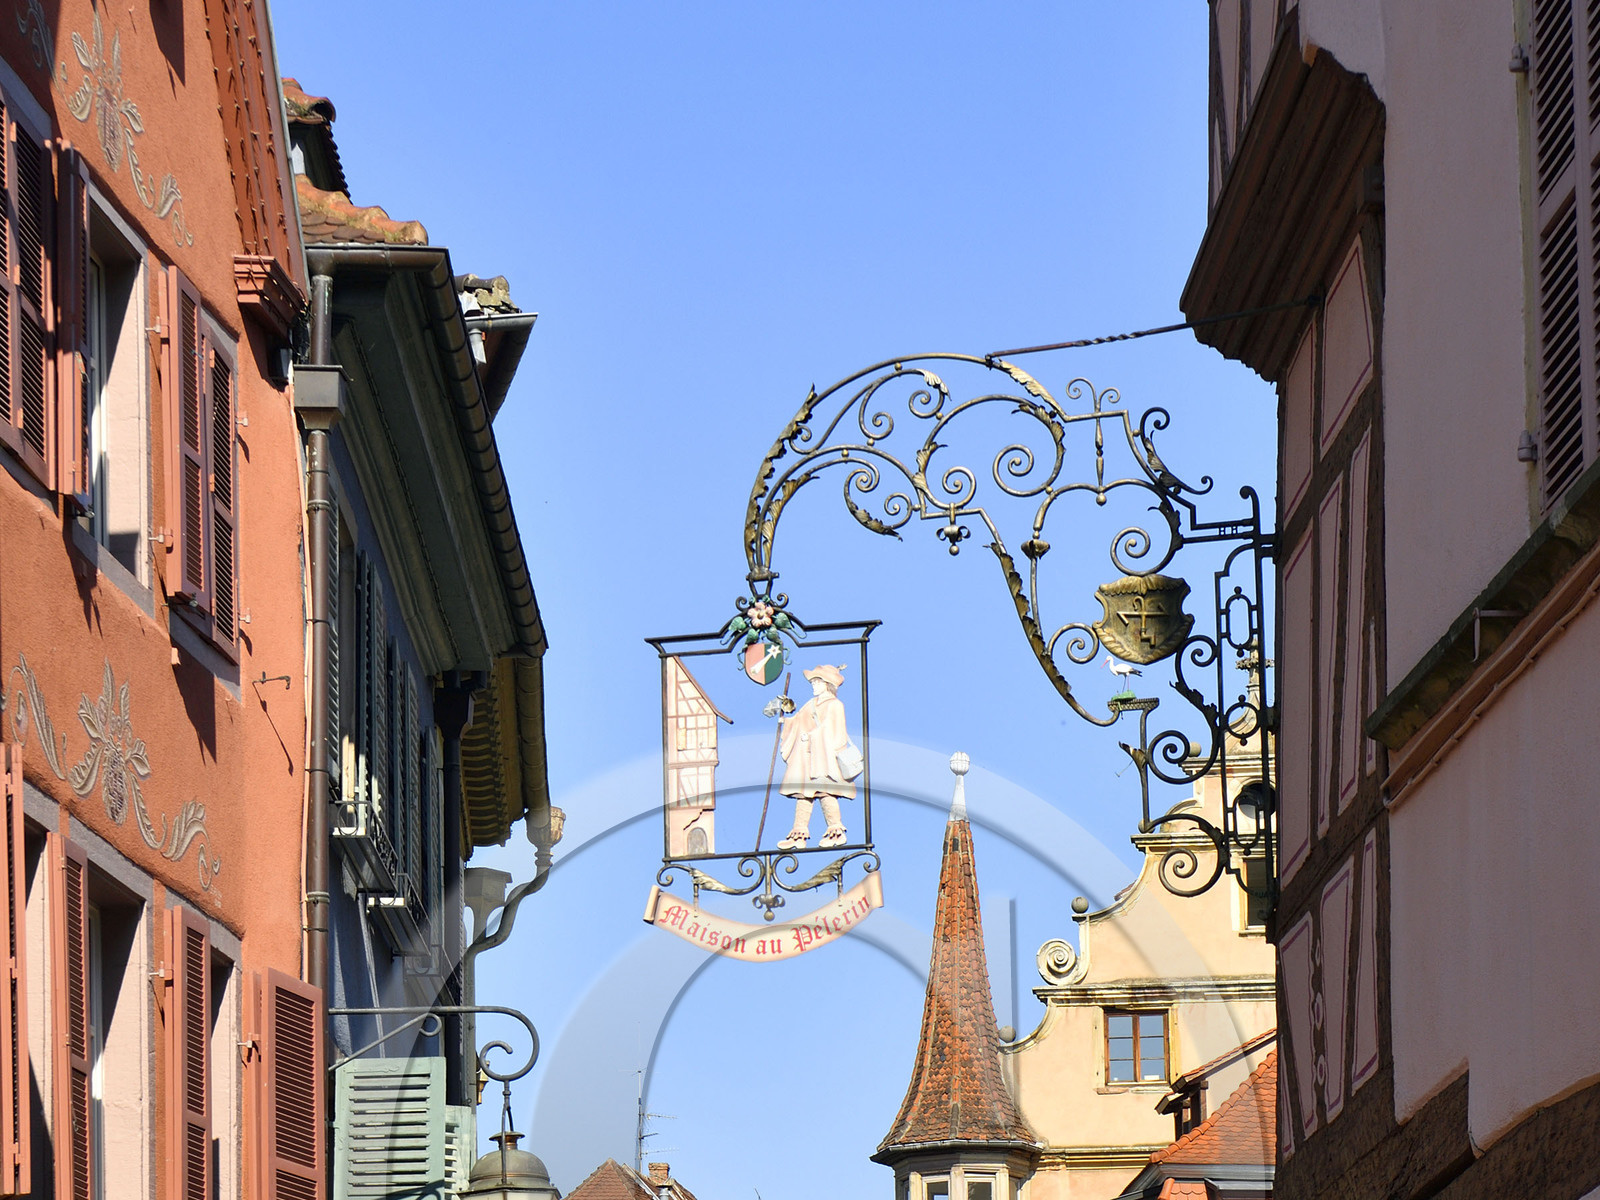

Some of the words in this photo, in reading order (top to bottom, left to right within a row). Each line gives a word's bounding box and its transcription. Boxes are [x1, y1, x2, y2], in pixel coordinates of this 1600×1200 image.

[659, 905, 746, 954] Maison
[755, 938, 782, 955] au
[790, 895, 871, 952] Pélerin
